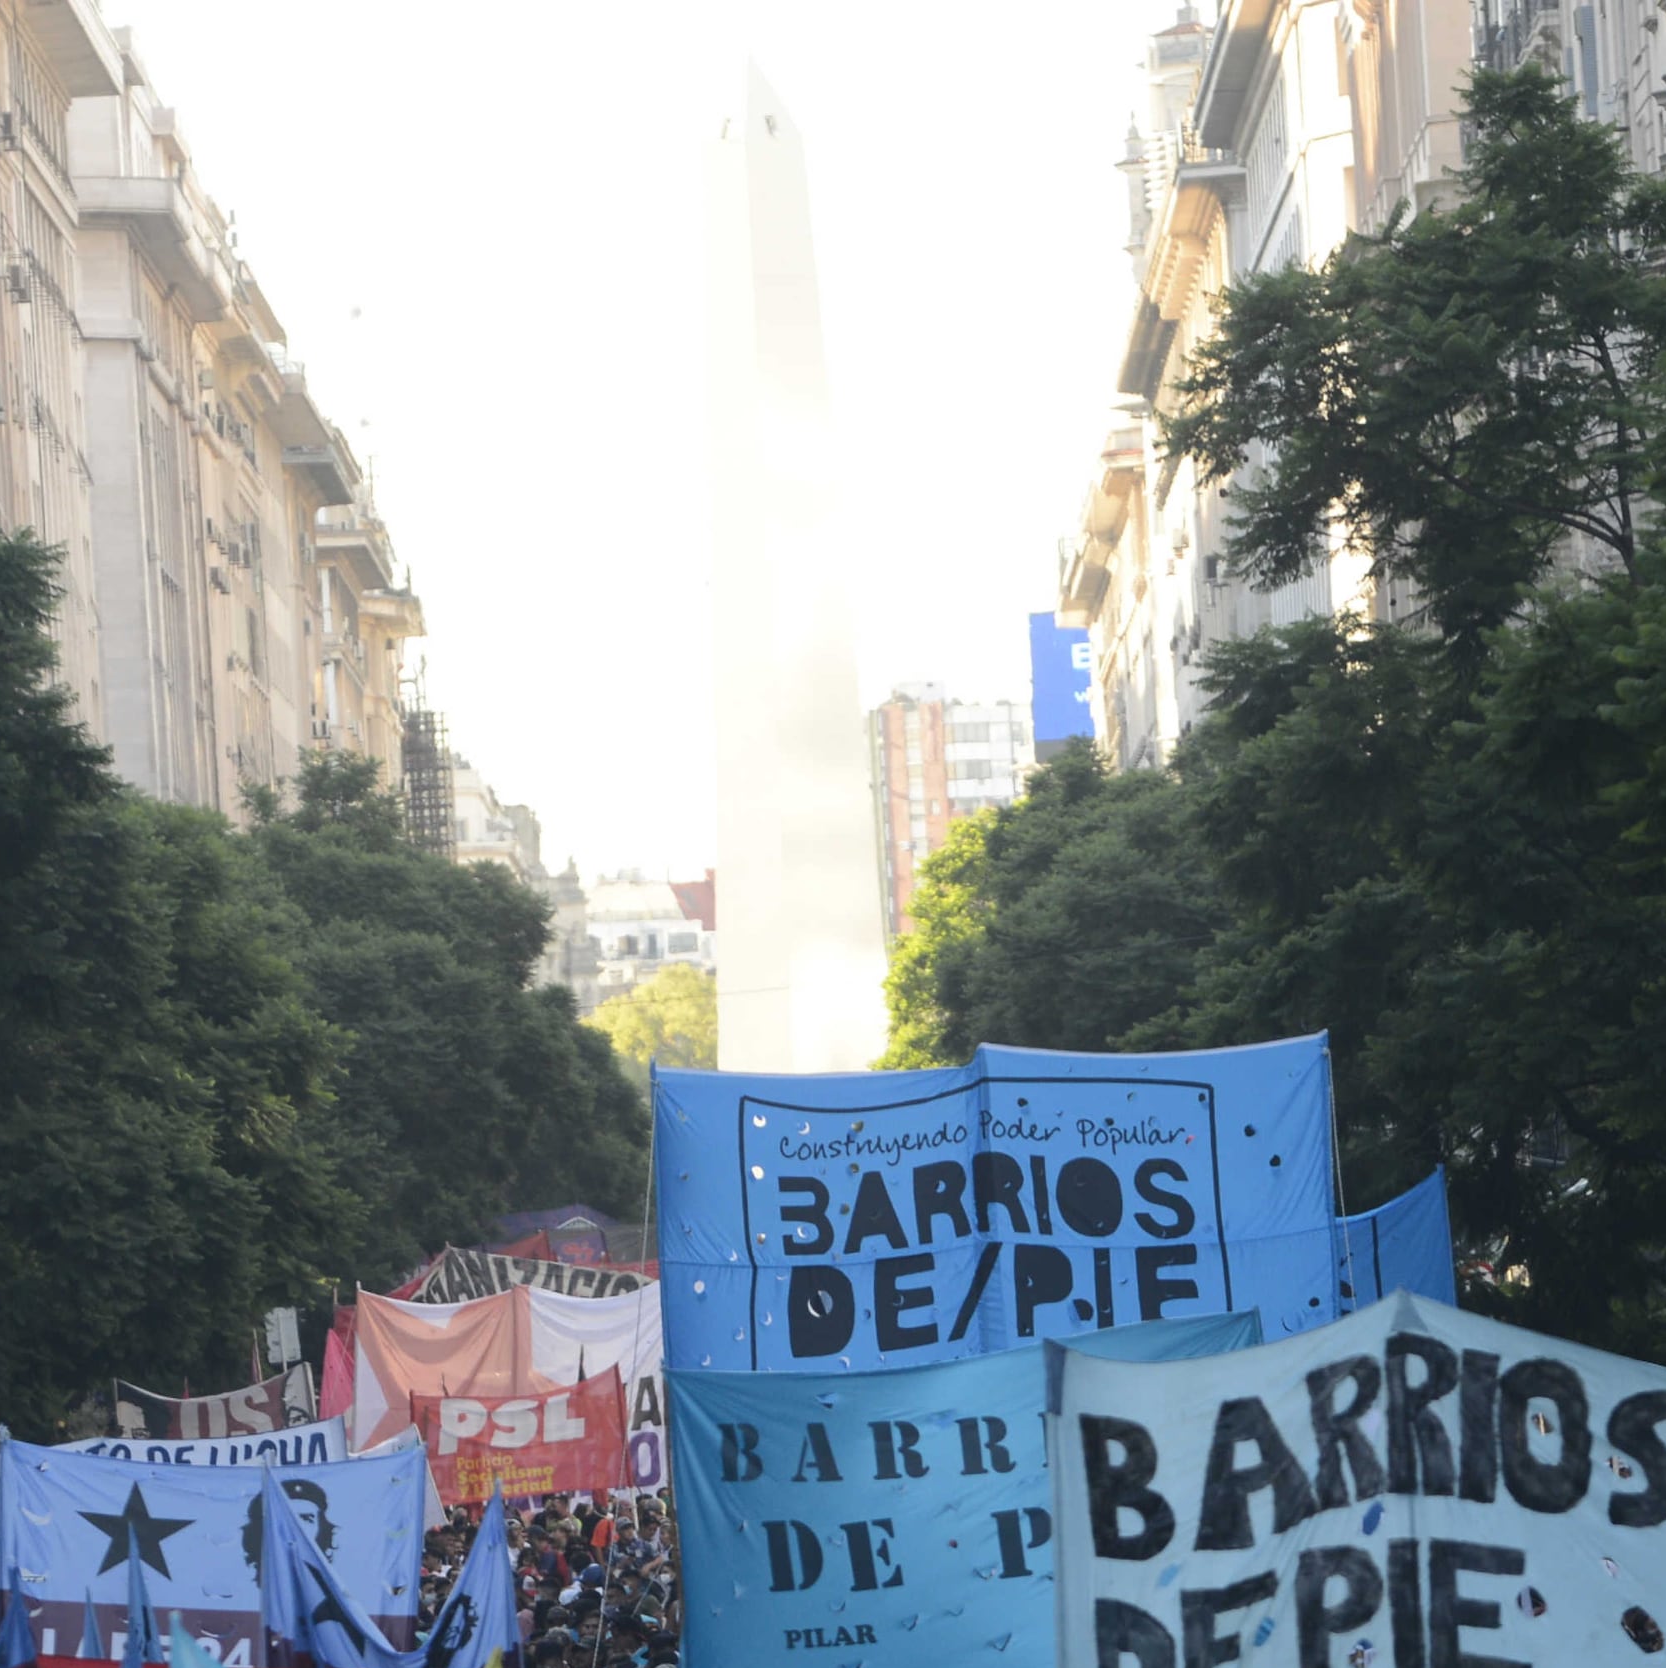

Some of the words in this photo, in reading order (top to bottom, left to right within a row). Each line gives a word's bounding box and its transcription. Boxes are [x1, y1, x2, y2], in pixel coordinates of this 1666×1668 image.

[779, 1123, 968, 1167] Construyendo
[979, 1110, 1061, 1141] Poder
[778, 1152, 1196, 1256] BARRIOS
[438, 1392, 585, 1455] PSL
[457, 1464, 555, 1486] Socialismo
[763, 1517, 905, 1592] DE
[785, 1623, 878, 1650] PILAR
